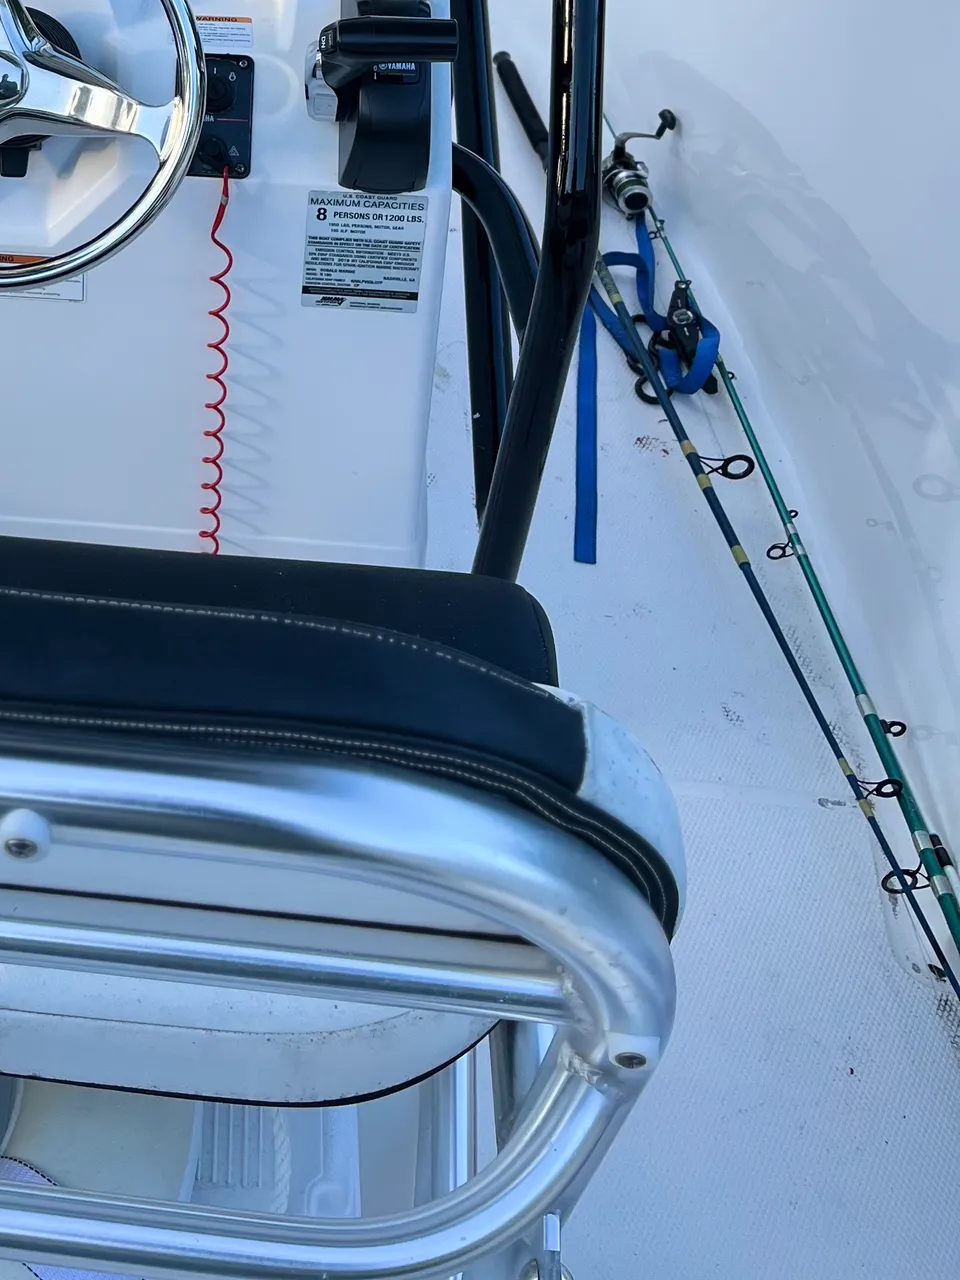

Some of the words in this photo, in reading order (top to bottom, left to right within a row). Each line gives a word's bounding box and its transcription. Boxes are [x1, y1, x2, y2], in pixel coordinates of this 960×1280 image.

[388, 62, 416, 70] YAMAHA
[310, 197, 360, 207] MAXIMUM
[363, 200, 425, 211] CAPACITIES
[316, 207, 327, 221] 8
[333, 211, 370, 220] PERSONS
[372, 213, 383, 221] OR
[385, 214, 405, 222] 1200
[407, 215, 424, 223] LBS.
